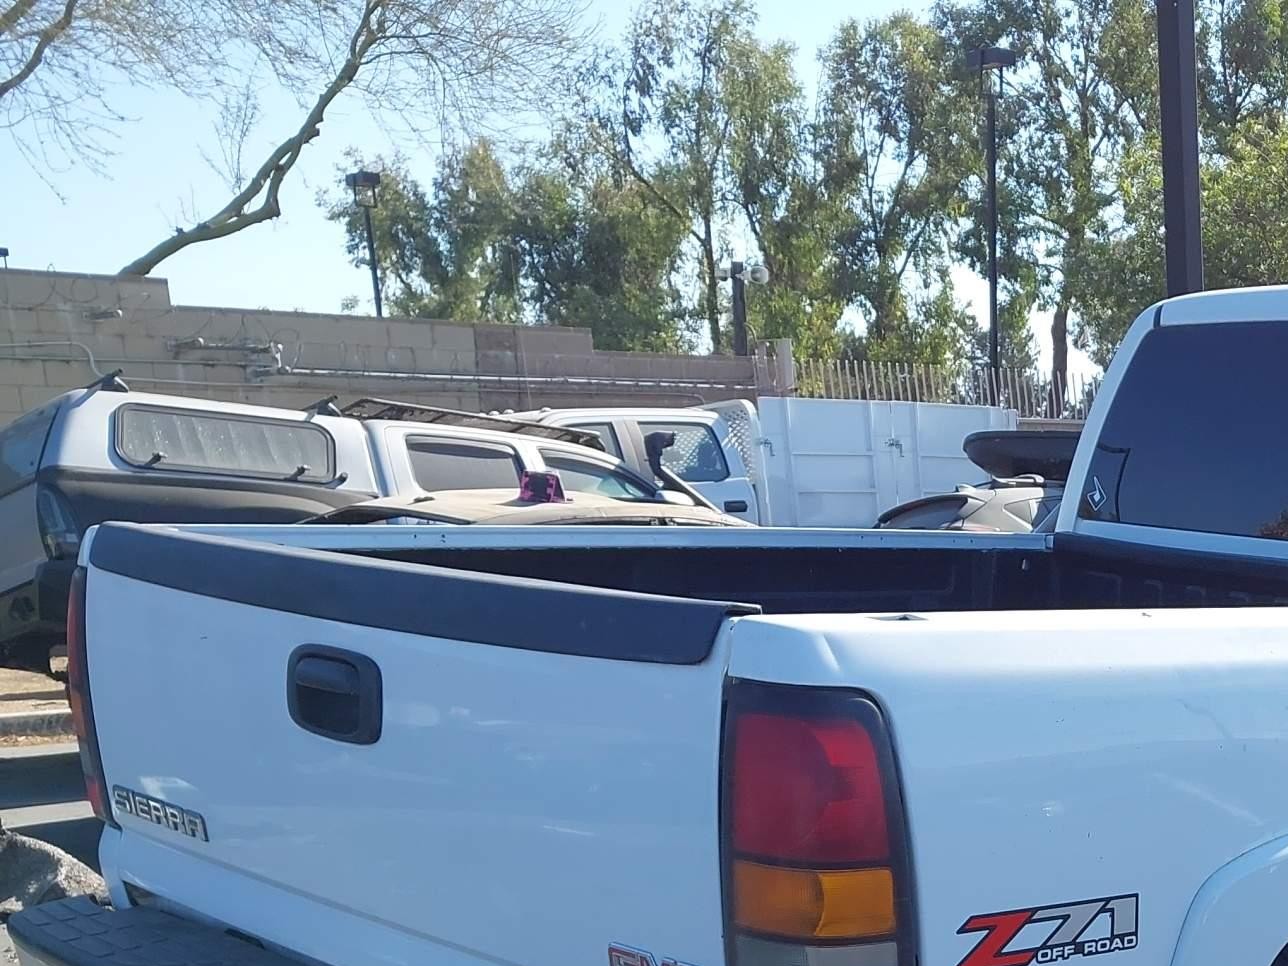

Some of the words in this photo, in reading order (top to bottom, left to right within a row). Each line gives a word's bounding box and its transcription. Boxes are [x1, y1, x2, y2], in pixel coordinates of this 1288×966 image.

[113, 786, 209, 841] SIERRA
[1037, 945, 1075, 963] OFF
[1084, 936, 1137, 955] ROAD
